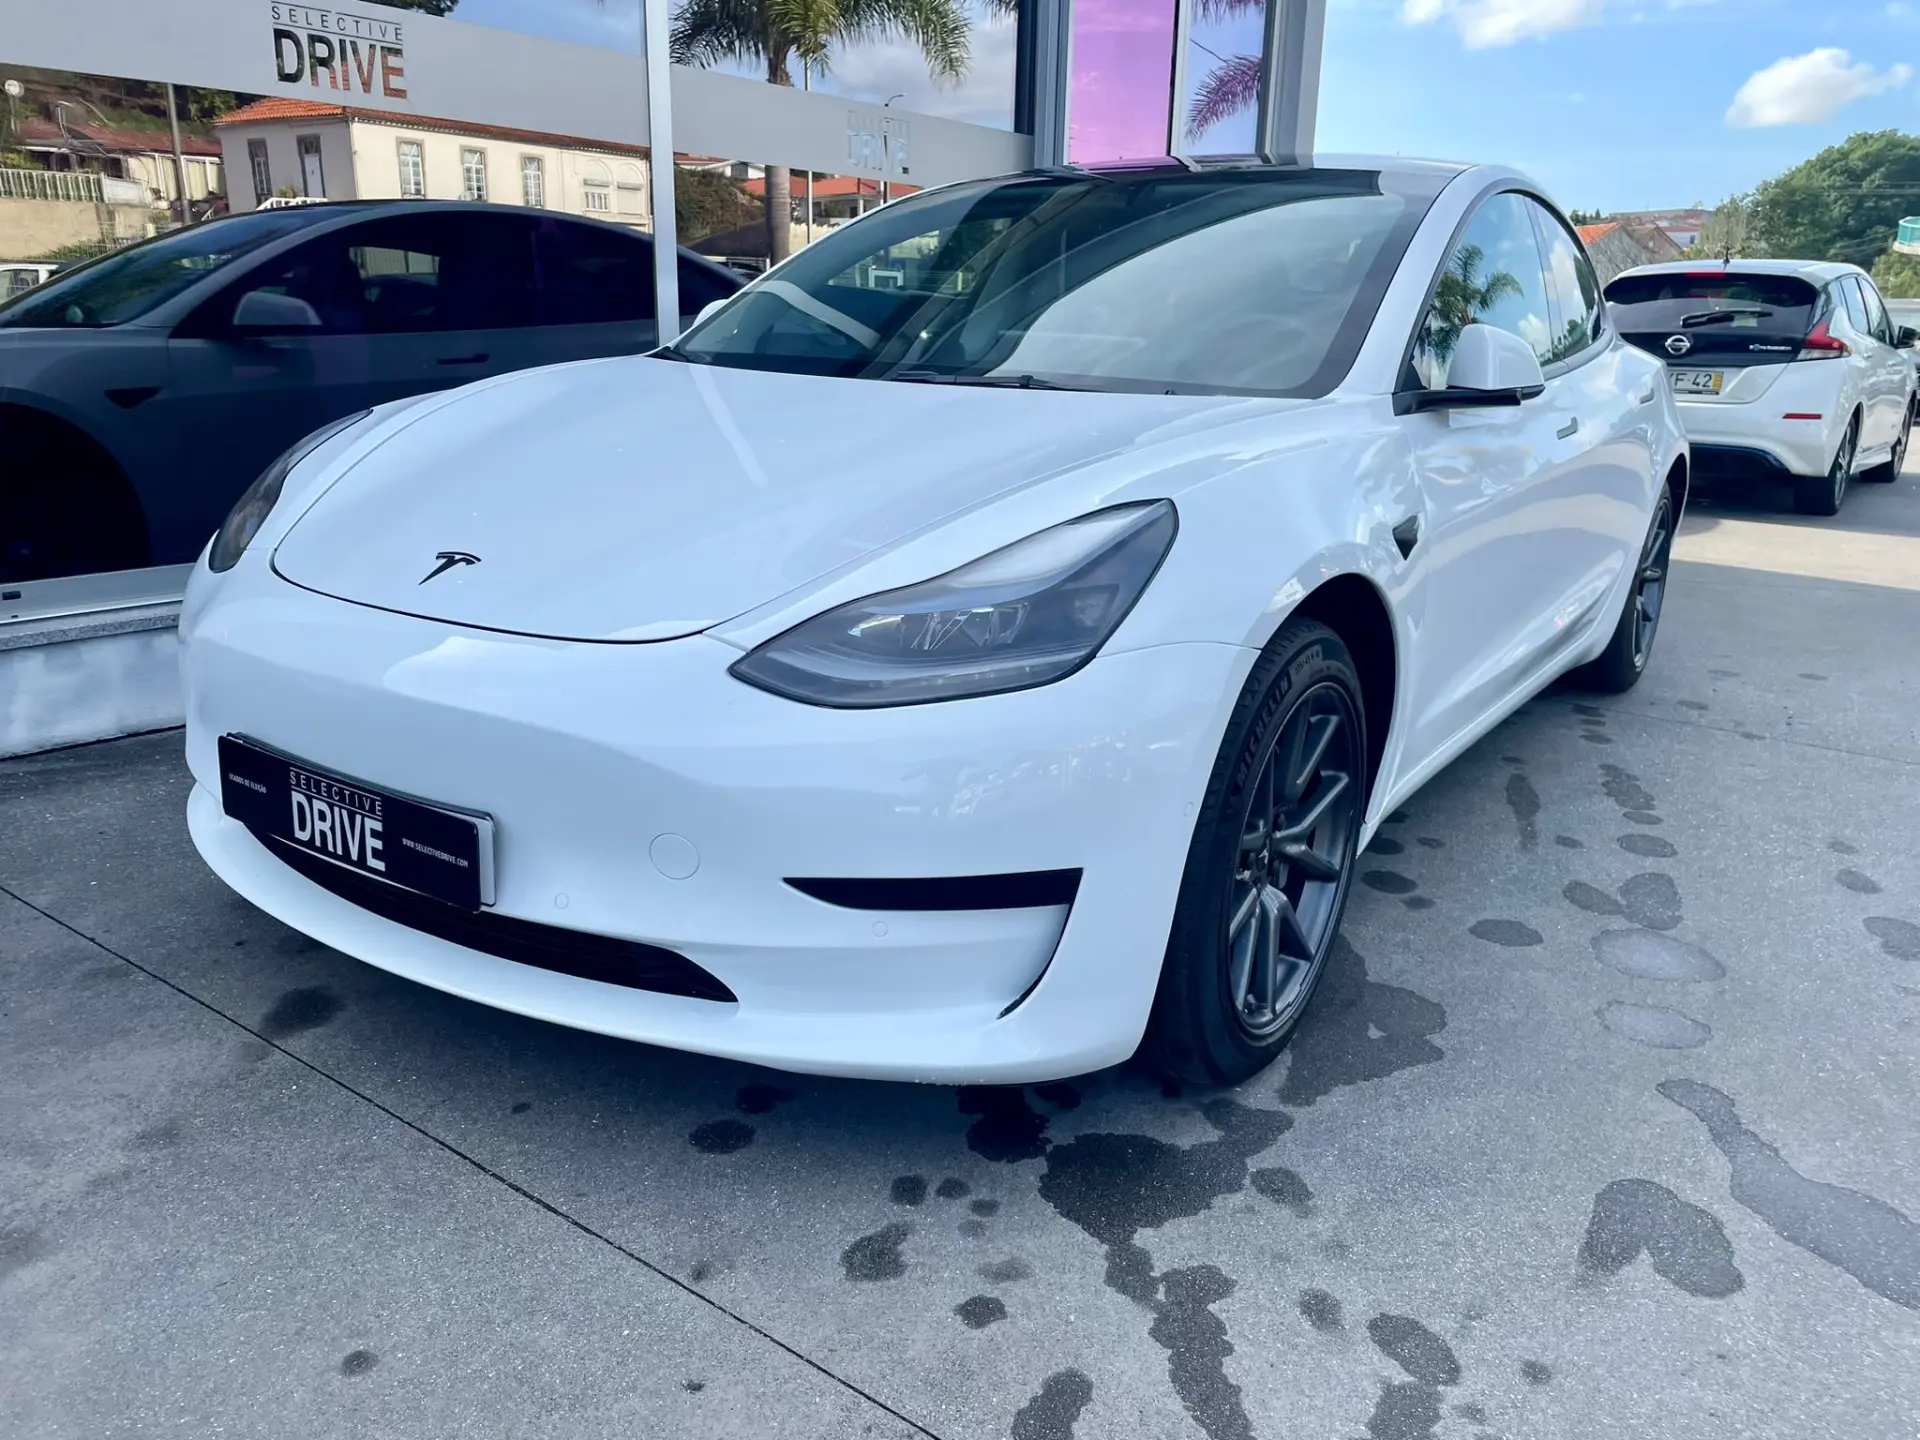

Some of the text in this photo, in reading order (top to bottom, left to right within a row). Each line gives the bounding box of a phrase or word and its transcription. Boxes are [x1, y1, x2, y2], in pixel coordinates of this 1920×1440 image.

[272, 6, 402, 41] SELECTIVE
[273, 28, 407, 99] DRIVE
[1237, 675, 1289, 787] MICHELIN
[289, 771, 383, 816] SELECTIVE
[291, 790, 386, 872] DRIVE
